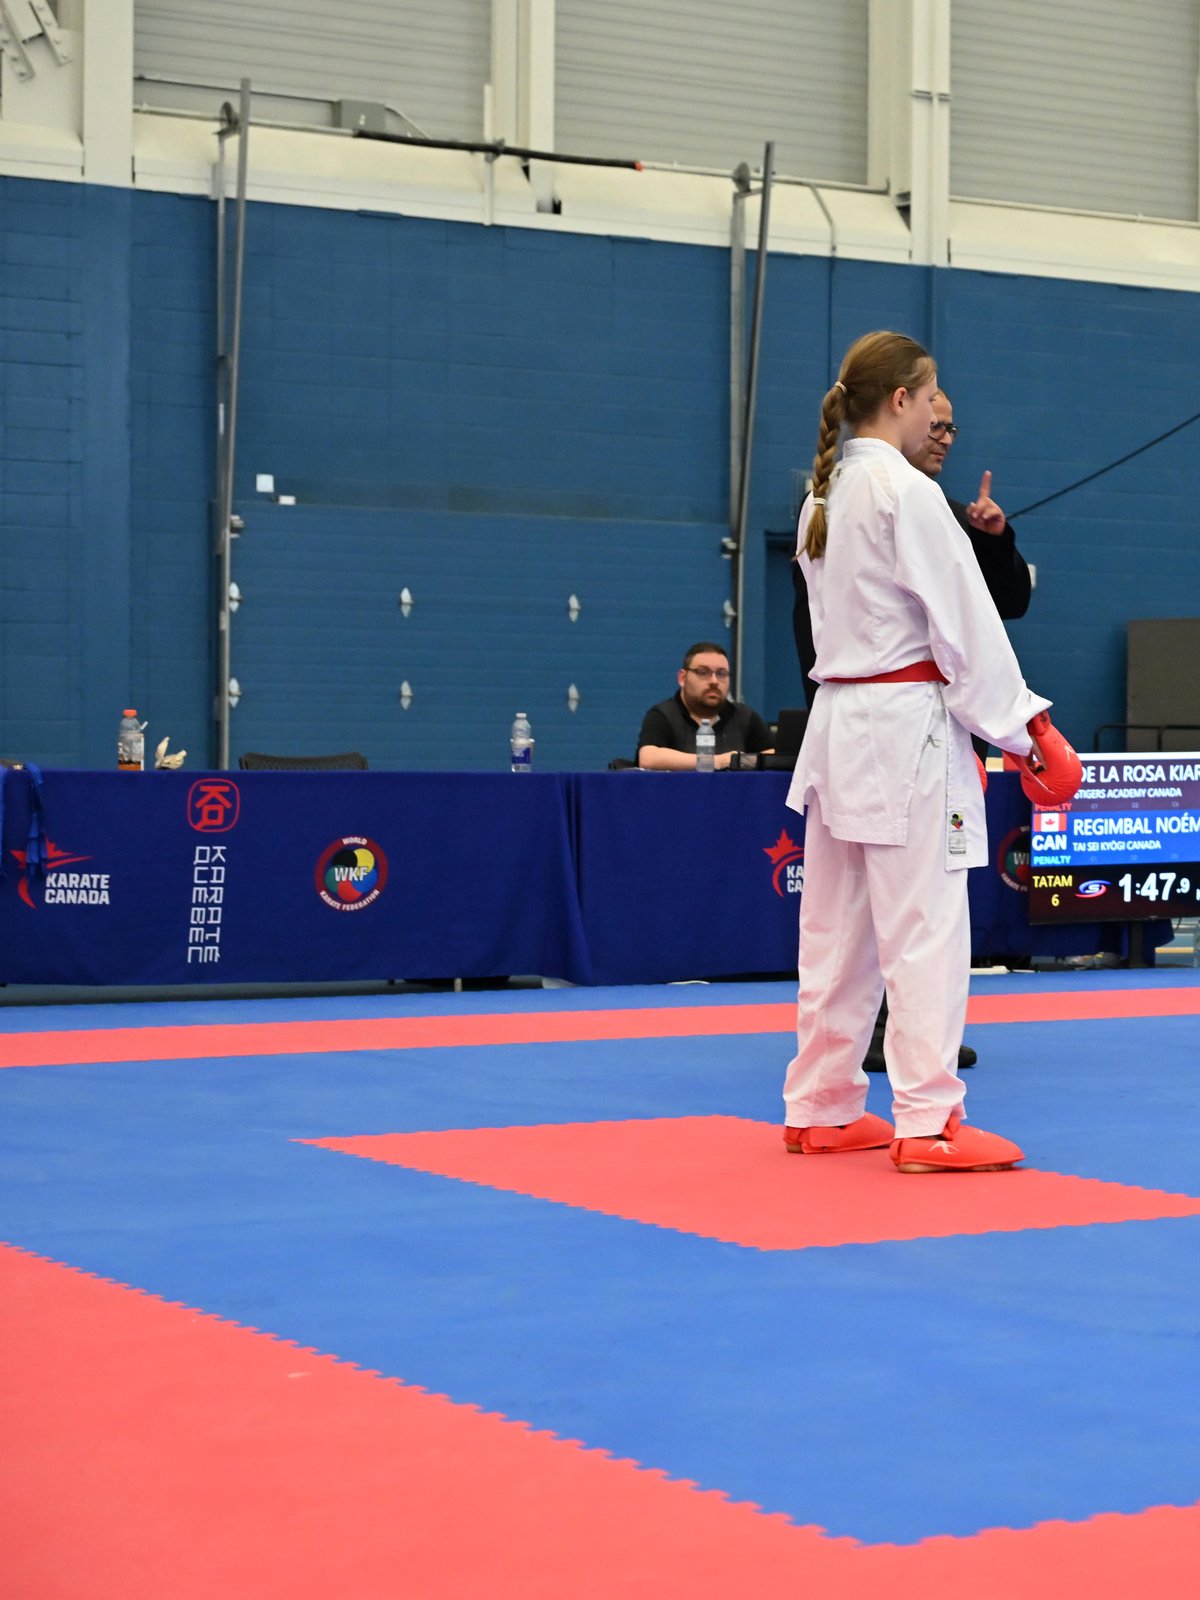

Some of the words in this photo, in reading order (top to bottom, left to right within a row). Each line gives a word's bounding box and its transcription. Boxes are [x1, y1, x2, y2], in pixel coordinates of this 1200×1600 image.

[1099, 765, 1120, 783] LA
[1123, 764, 1166, 782] ROSA
[1106, 788, 1146, 798] ACADEMY
[1147, 787, 1183, 798] CANADA
[1073, 817, 1152, 836] REGIMBAL
[1031, 834, 1067, 851] CAN
[1072, 842, 1086, 852] TAI
[1087, 841, 1099, 852] SEI
[1126, 839, 1162, 850] CANADA
[1033, 855, 1072, 865] PENALTY
[46, 872, 110, 889] KARATE
[334, 866, 368, 881] WKF
[1032, 875, 1073, 888] TATAM
[45, 889, 110, 905] CANADA
[1051, 893, 1060, 907] 6
